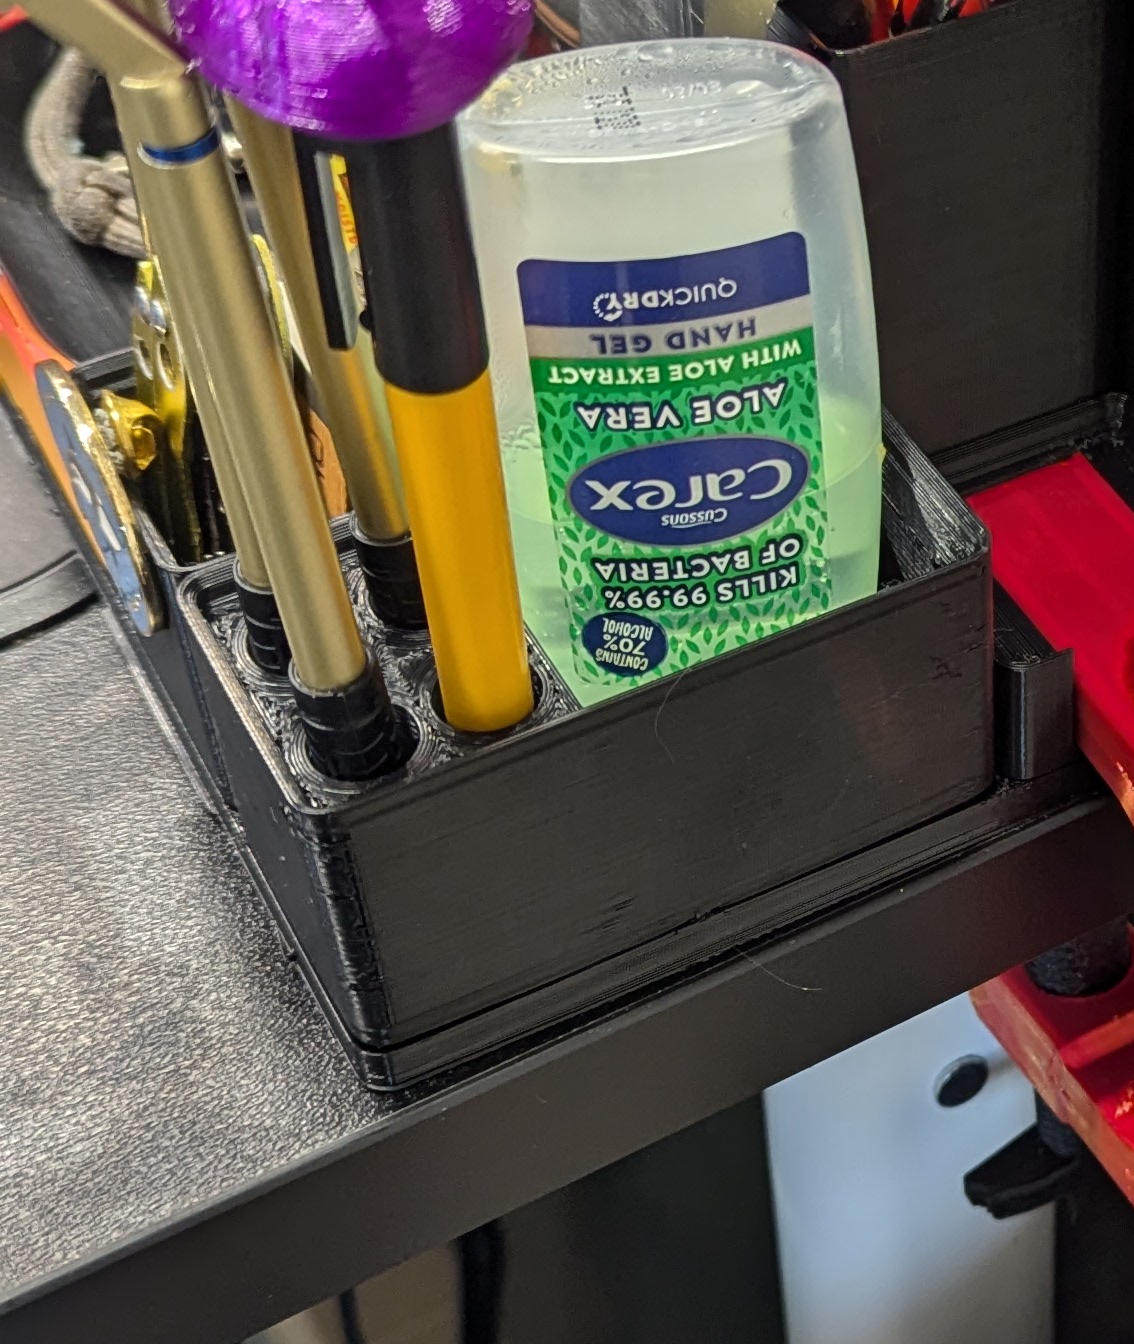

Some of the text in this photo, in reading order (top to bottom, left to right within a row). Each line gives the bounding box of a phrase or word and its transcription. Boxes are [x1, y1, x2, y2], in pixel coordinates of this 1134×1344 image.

[603, 277, 738, 310] QUICKDRY
[589, 316, 757, 356] HAND GEL
[547, 338, 803, 385] WITH ALOE EXTRACT
[576, 381, 787, 431] ALOE VERA
[584, 458, 793, 511] Carex
[660, 507, 729, 529] Cussons
[594, 537, 802, 582] OF BACTERIA
[604, 565, 798, 609] KILLS 99.99%
[602, 617, 655, 641] ALCOHOL
[602, 634, 648, 656] 70%
[595, 647, 649, 672] CONTAINS
